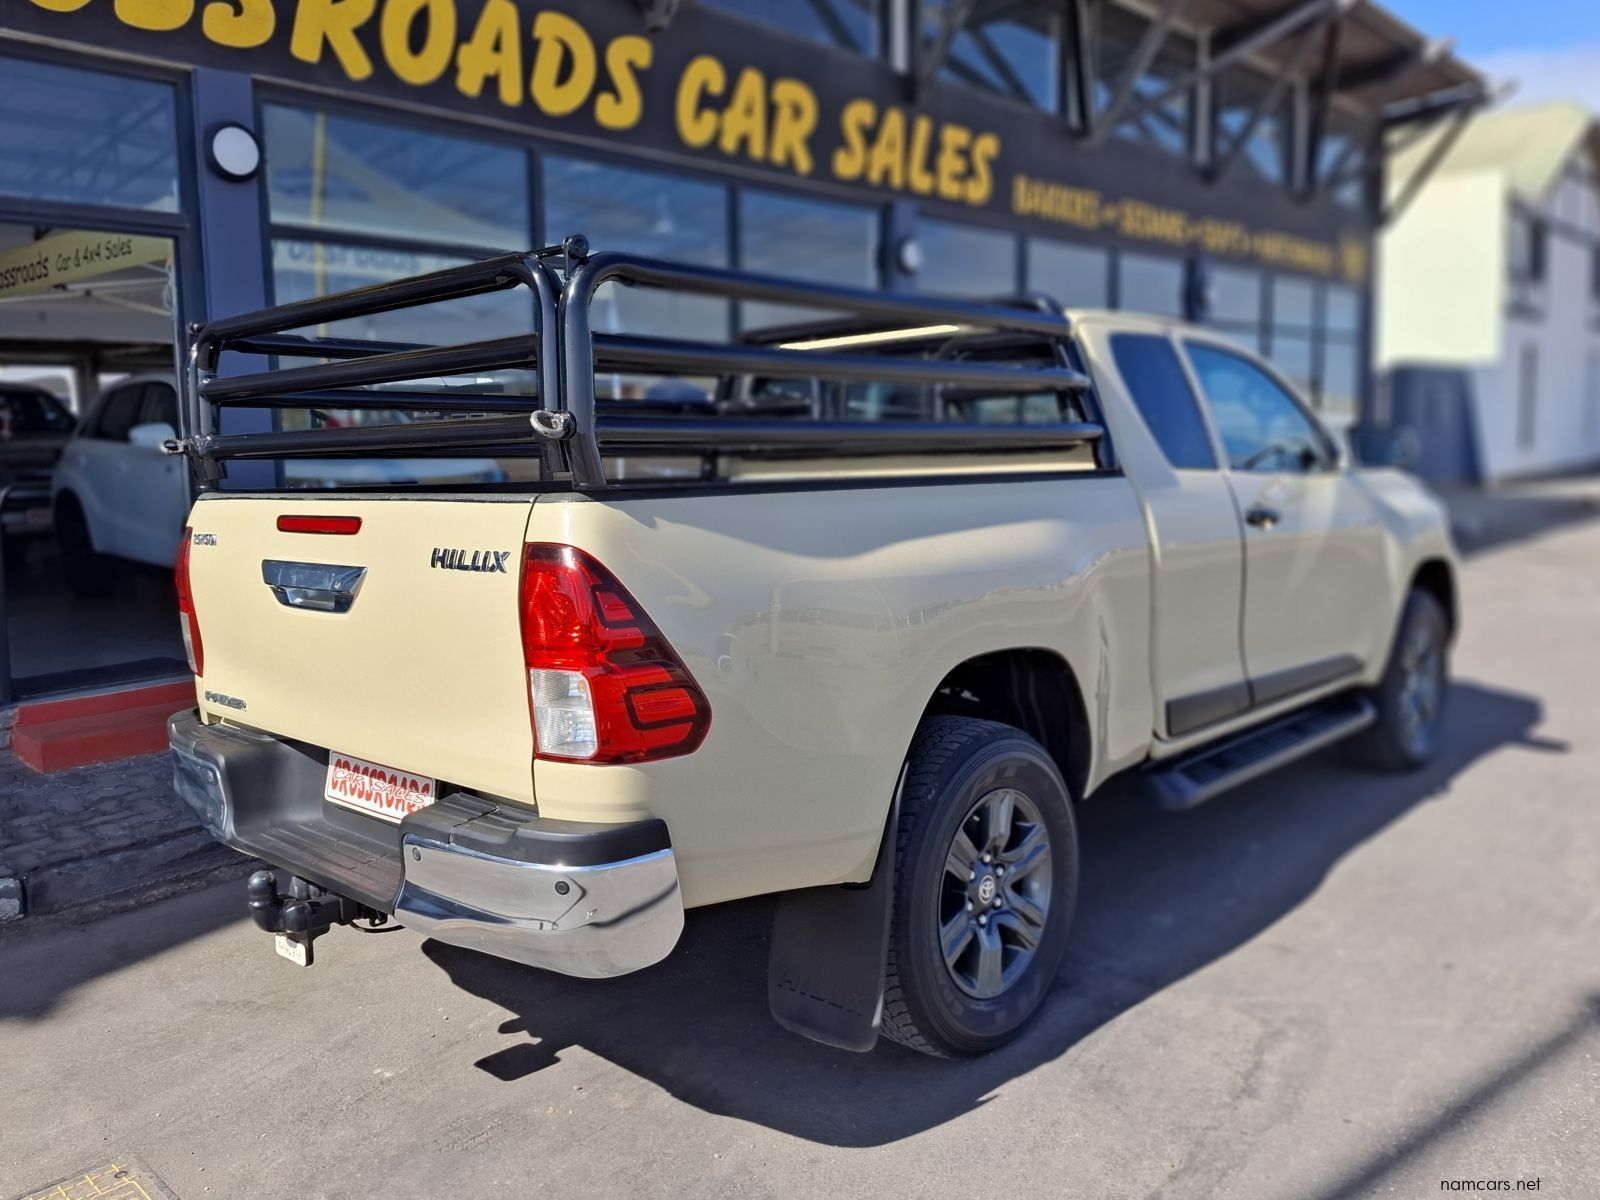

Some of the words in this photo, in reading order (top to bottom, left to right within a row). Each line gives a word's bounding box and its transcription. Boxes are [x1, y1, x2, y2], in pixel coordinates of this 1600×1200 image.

[30, 0, 653, 130] ROADS
[675, 54, 819, 175] CAR
[832, 100, 999, 205] SALES
[104, 237, 133, 261] Sales
[430, 547, 512, 573] HILUX
